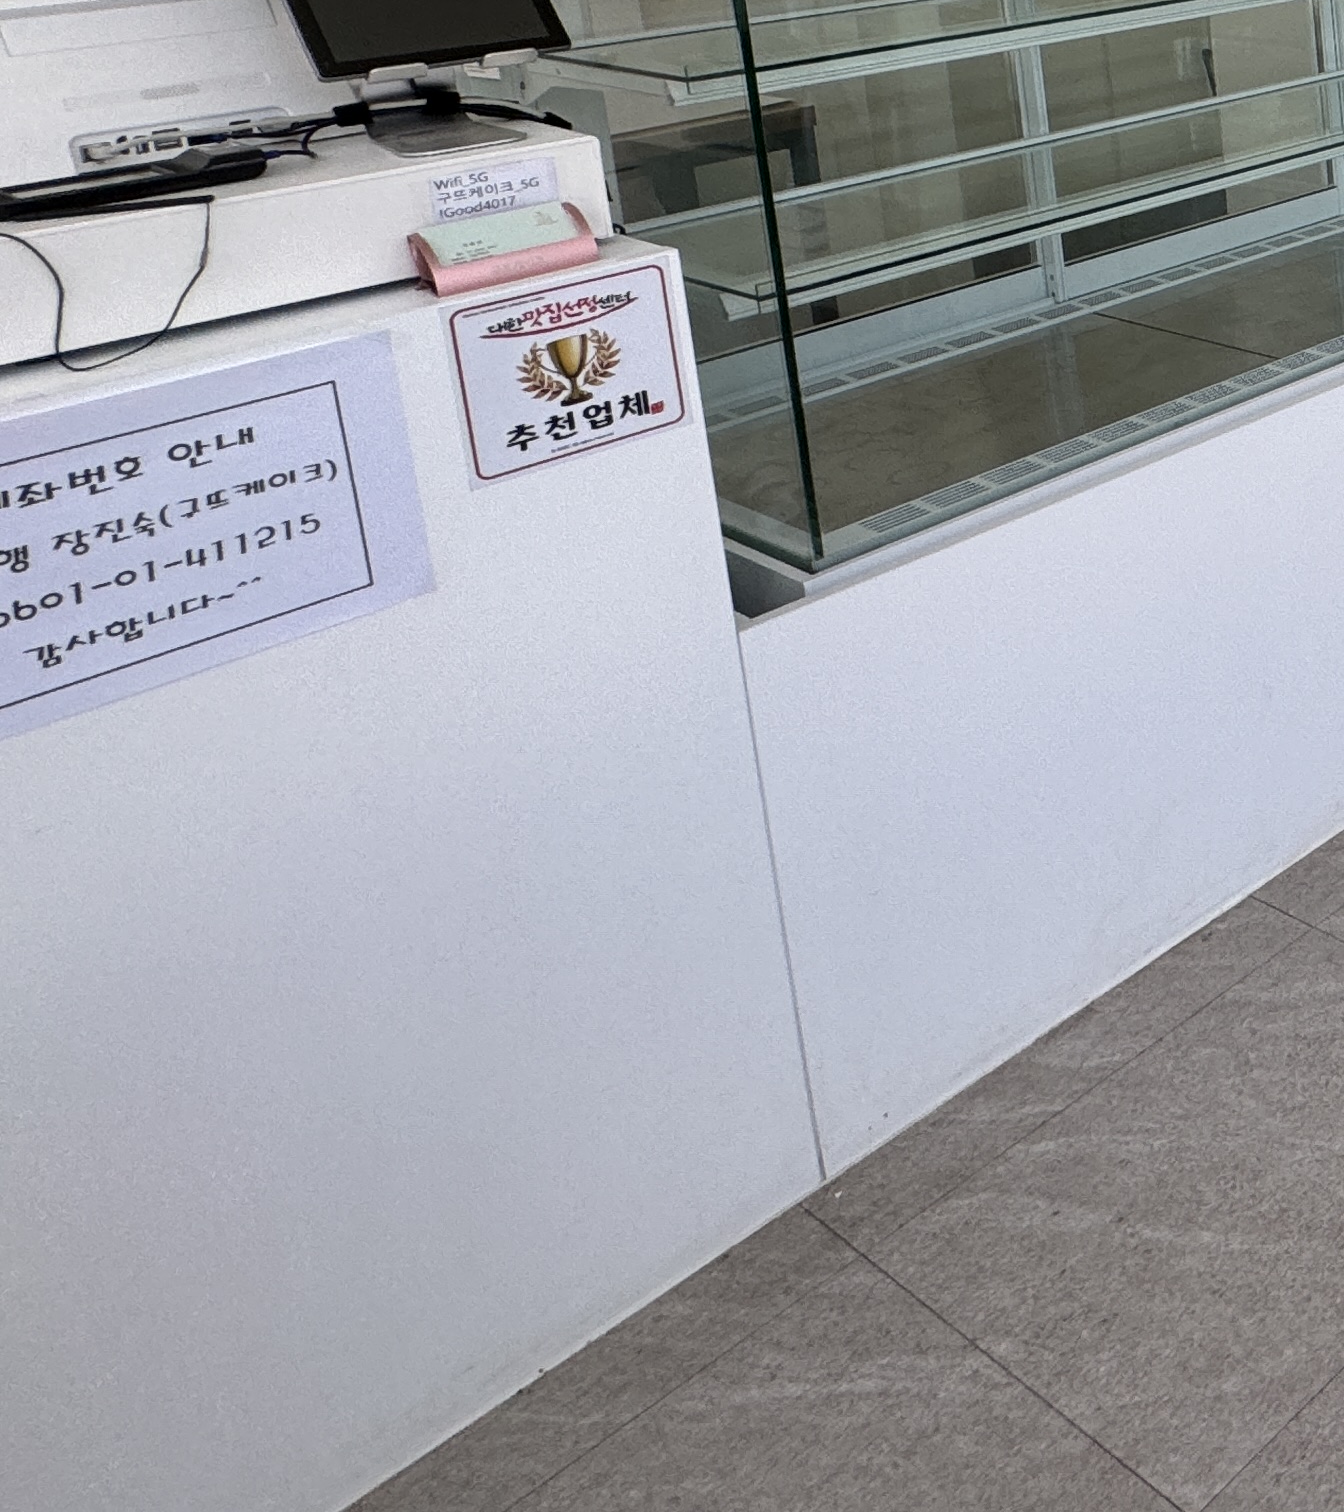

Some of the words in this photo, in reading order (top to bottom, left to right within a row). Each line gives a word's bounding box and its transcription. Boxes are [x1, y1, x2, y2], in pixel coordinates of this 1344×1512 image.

[168, 426, 256, 469] 안내
[506, 390, 651, 451] 추천업체
[51, 458, 338, 557] 장진숙(구뜨케이크)
